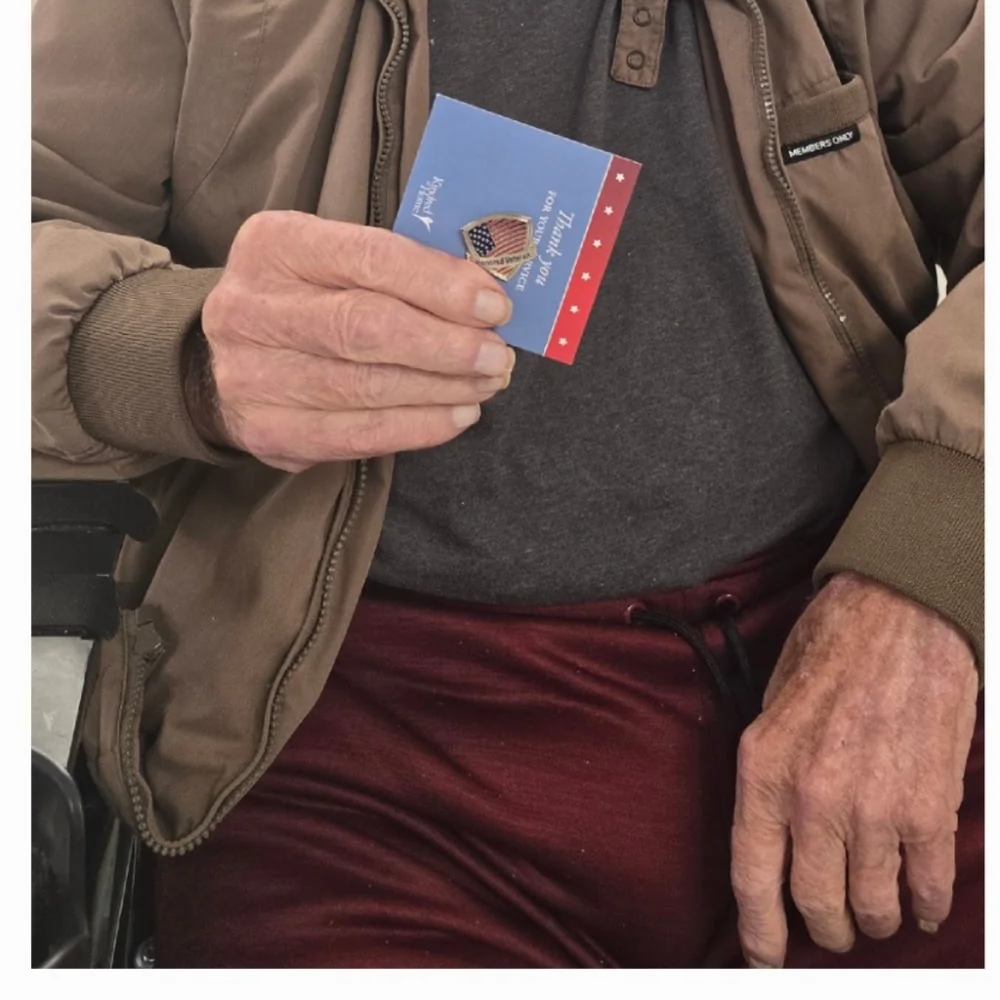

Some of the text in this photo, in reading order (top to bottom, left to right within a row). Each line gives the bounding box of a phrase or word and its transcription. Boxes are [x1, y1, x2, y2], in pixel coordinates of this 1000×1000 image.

[788, 130, 853, 158] MEMBERS ONLY
[541, 189, 558, 213] FOR
[535, 209, 576, 287] Thank you
